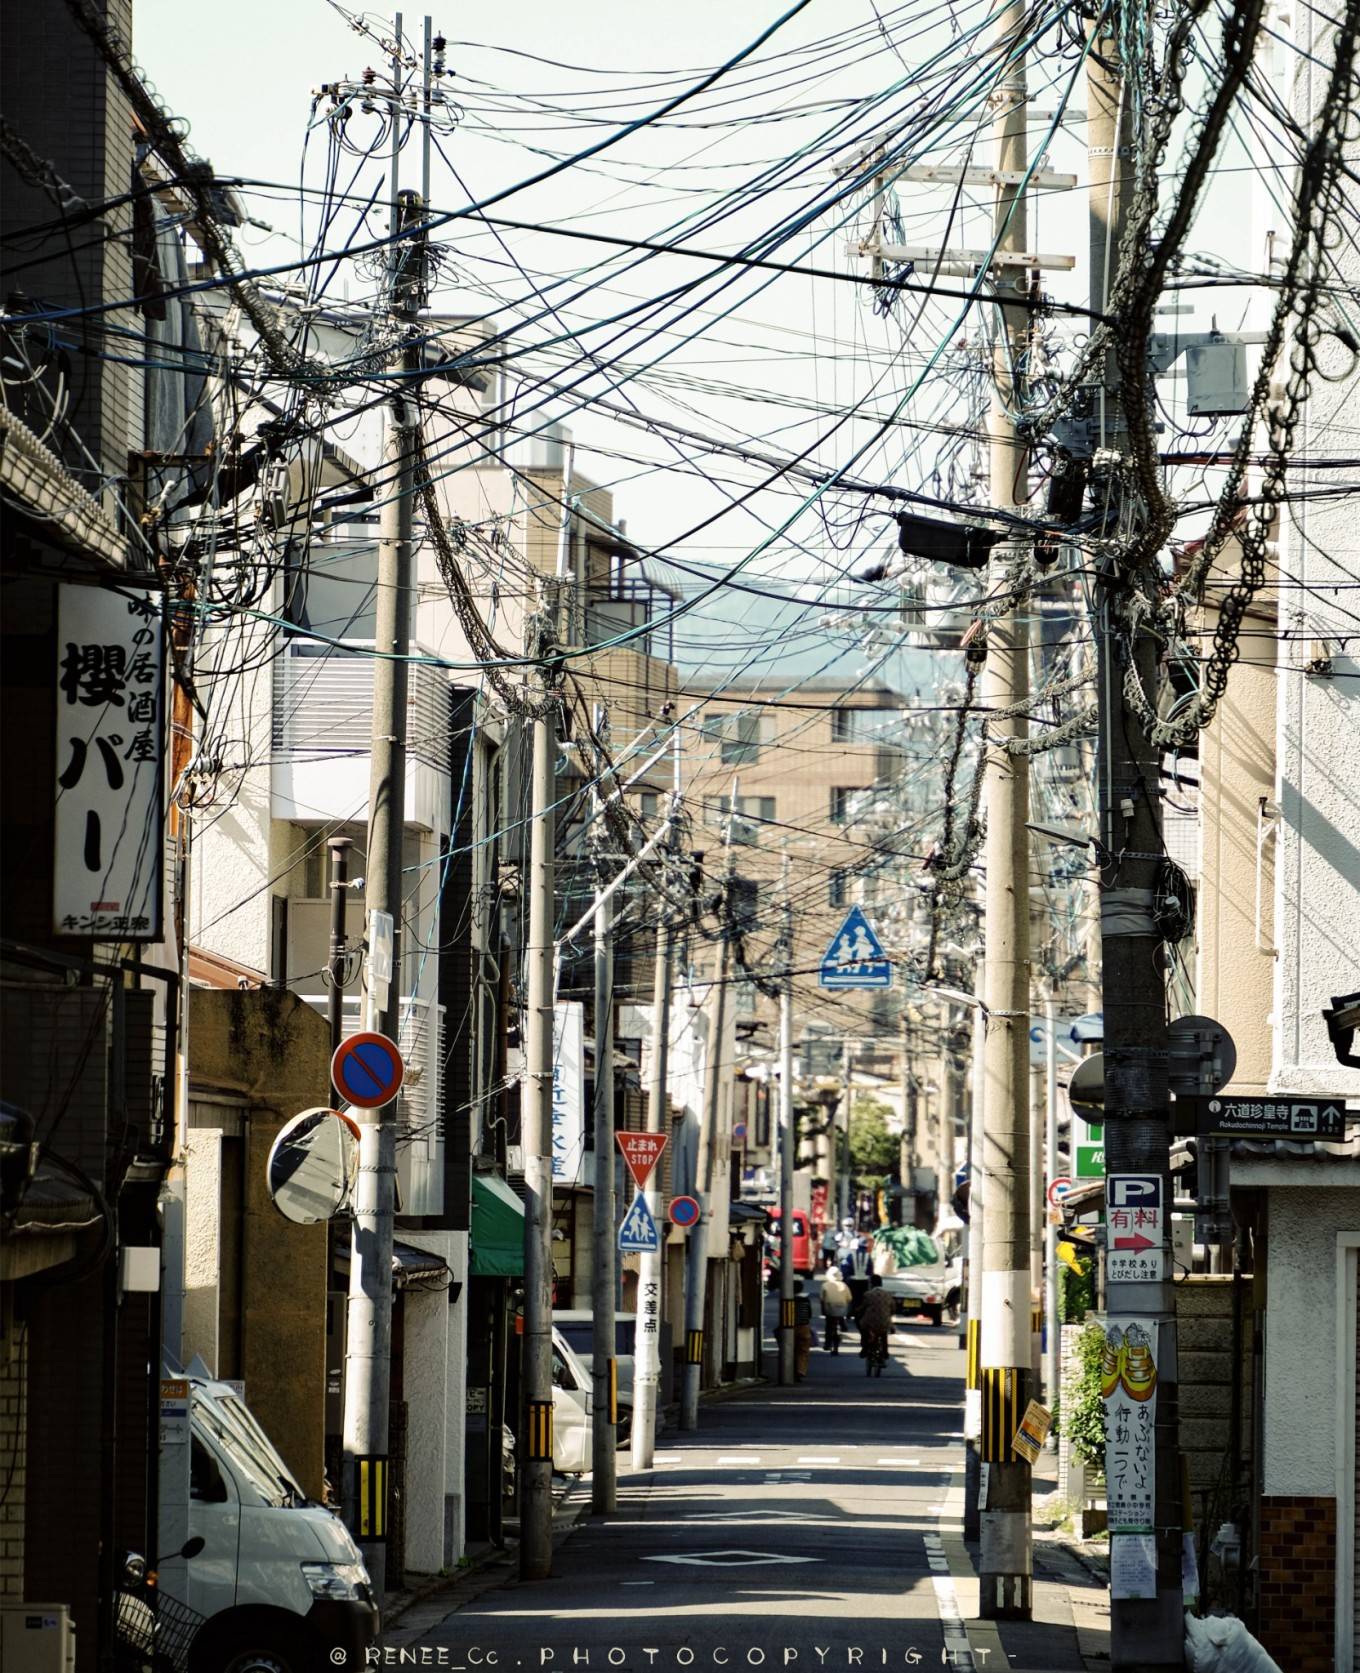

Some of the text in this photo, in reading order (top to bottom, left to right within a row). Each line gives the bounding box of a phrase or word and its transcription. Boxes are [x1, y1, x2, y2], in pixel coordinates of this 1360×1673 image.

[124, 589, 159, 764] 味の居酒屋
[59, 642, 126, 873] 櫻バー
[1224, 1103, 1289, 1120] 六道珍皇寺
[626, 1138, 658, 1152] 止まれ
[631, 1154, 654, 1165] STOP
[1114, 1180, 1156, 1206] P
[1111, 1209, 1159, 1229] 有料
[1112, 1259, 1158, 1269] 中学校あり
[1112, 1270, 1158, 1280] とびだし注意
[644, 1282, 657, 1333] 交差点
[1114, 1403, 1132, 1489] 行動一つで
[1133, 1404, 1151, 1489] あぶないよ
